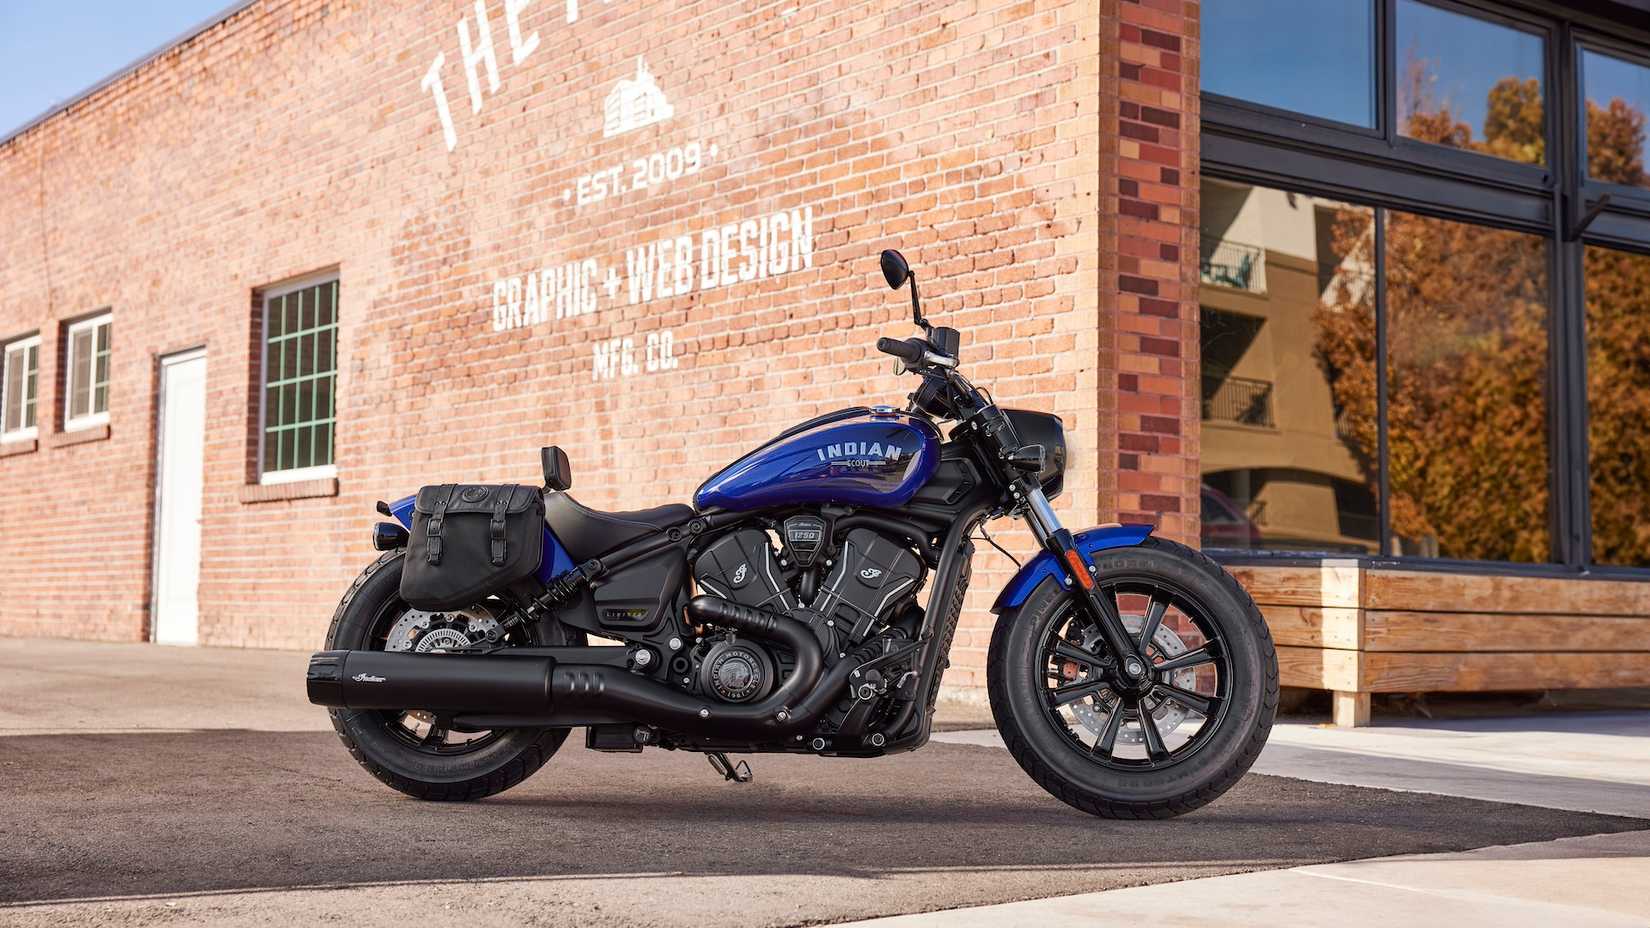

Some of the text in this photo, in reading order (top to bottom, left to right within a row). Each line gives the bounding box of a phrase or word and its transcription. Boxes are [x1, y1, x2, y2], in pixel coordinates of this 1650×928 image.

[421, 0, 541, 153] THE
[577, 143, 700, 206] EST. 2009
[492, 257, 598, 332] GRAPHIC
[626, 235, 693, 304] WEB
[701, 206, 812, 290] DESIGN
[592, 331, 678, 382] MFG. CO.
[817, 442, 902, 461] INDIAN
[847, 460, 869, 468] SCOUT
